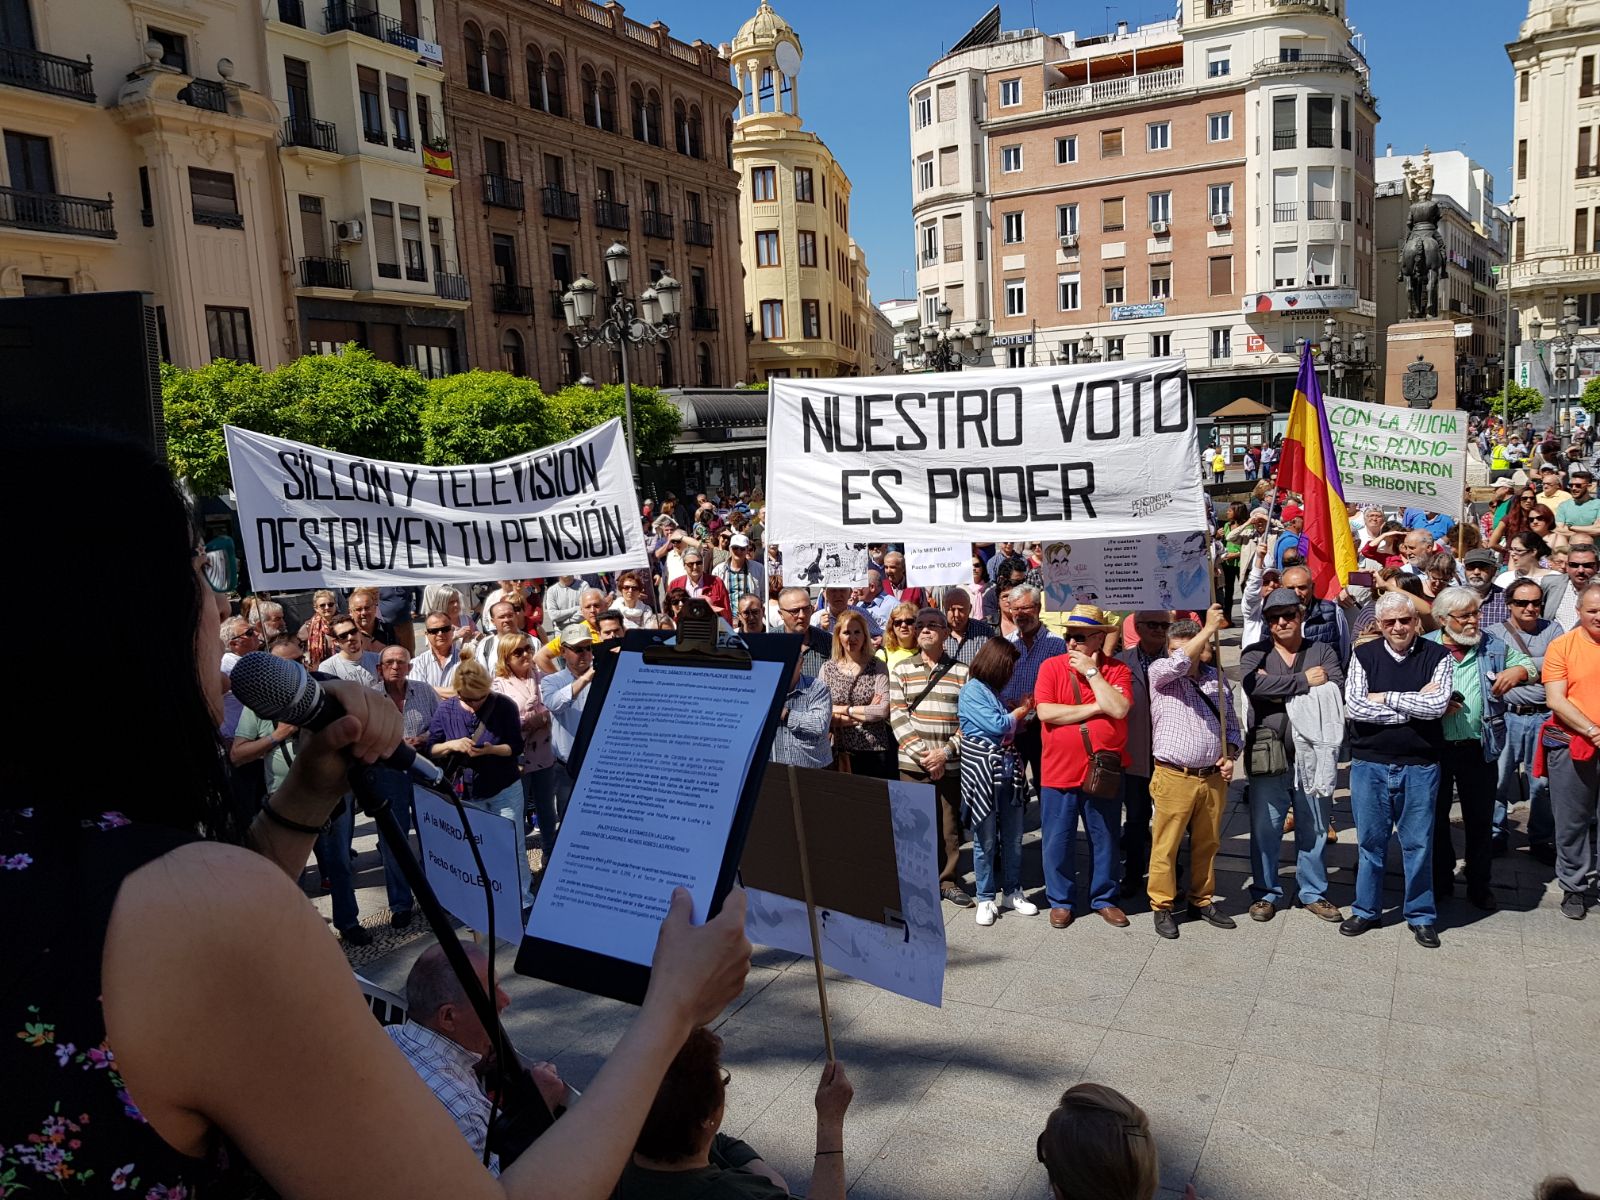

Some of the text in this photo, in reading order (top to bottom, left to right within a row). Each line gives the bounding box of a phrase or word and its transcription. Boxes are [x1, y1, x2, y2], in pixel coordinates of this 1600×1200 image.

[993, 335, 1032, 345] HOTEL
[801, 370, 1188, 453] NUESTRO VOTO
[1330, 406, 1457, 434] CON LA HUCHA
[1330, 430, 1457, 456] DE LAS PENSIO-
[400, 468, 418, 507] Y
[430, 441, 600, 507] TELEVISIÓN
[1364, 454, 1453, 479] ARRASARON
[842, 461, 1097, 525] ES PODER
[1363, 473, 1437, 497] BRIBONES
[256, 499, 626, 574] DESTRUYEN TU PENSIÓN
[423, 811, 431, 823] ¡A
[431, 815, 438, 827] la
[474, 833, 484, 845] el
[429, 850, 502, 894] Pacto de TOLEO!
